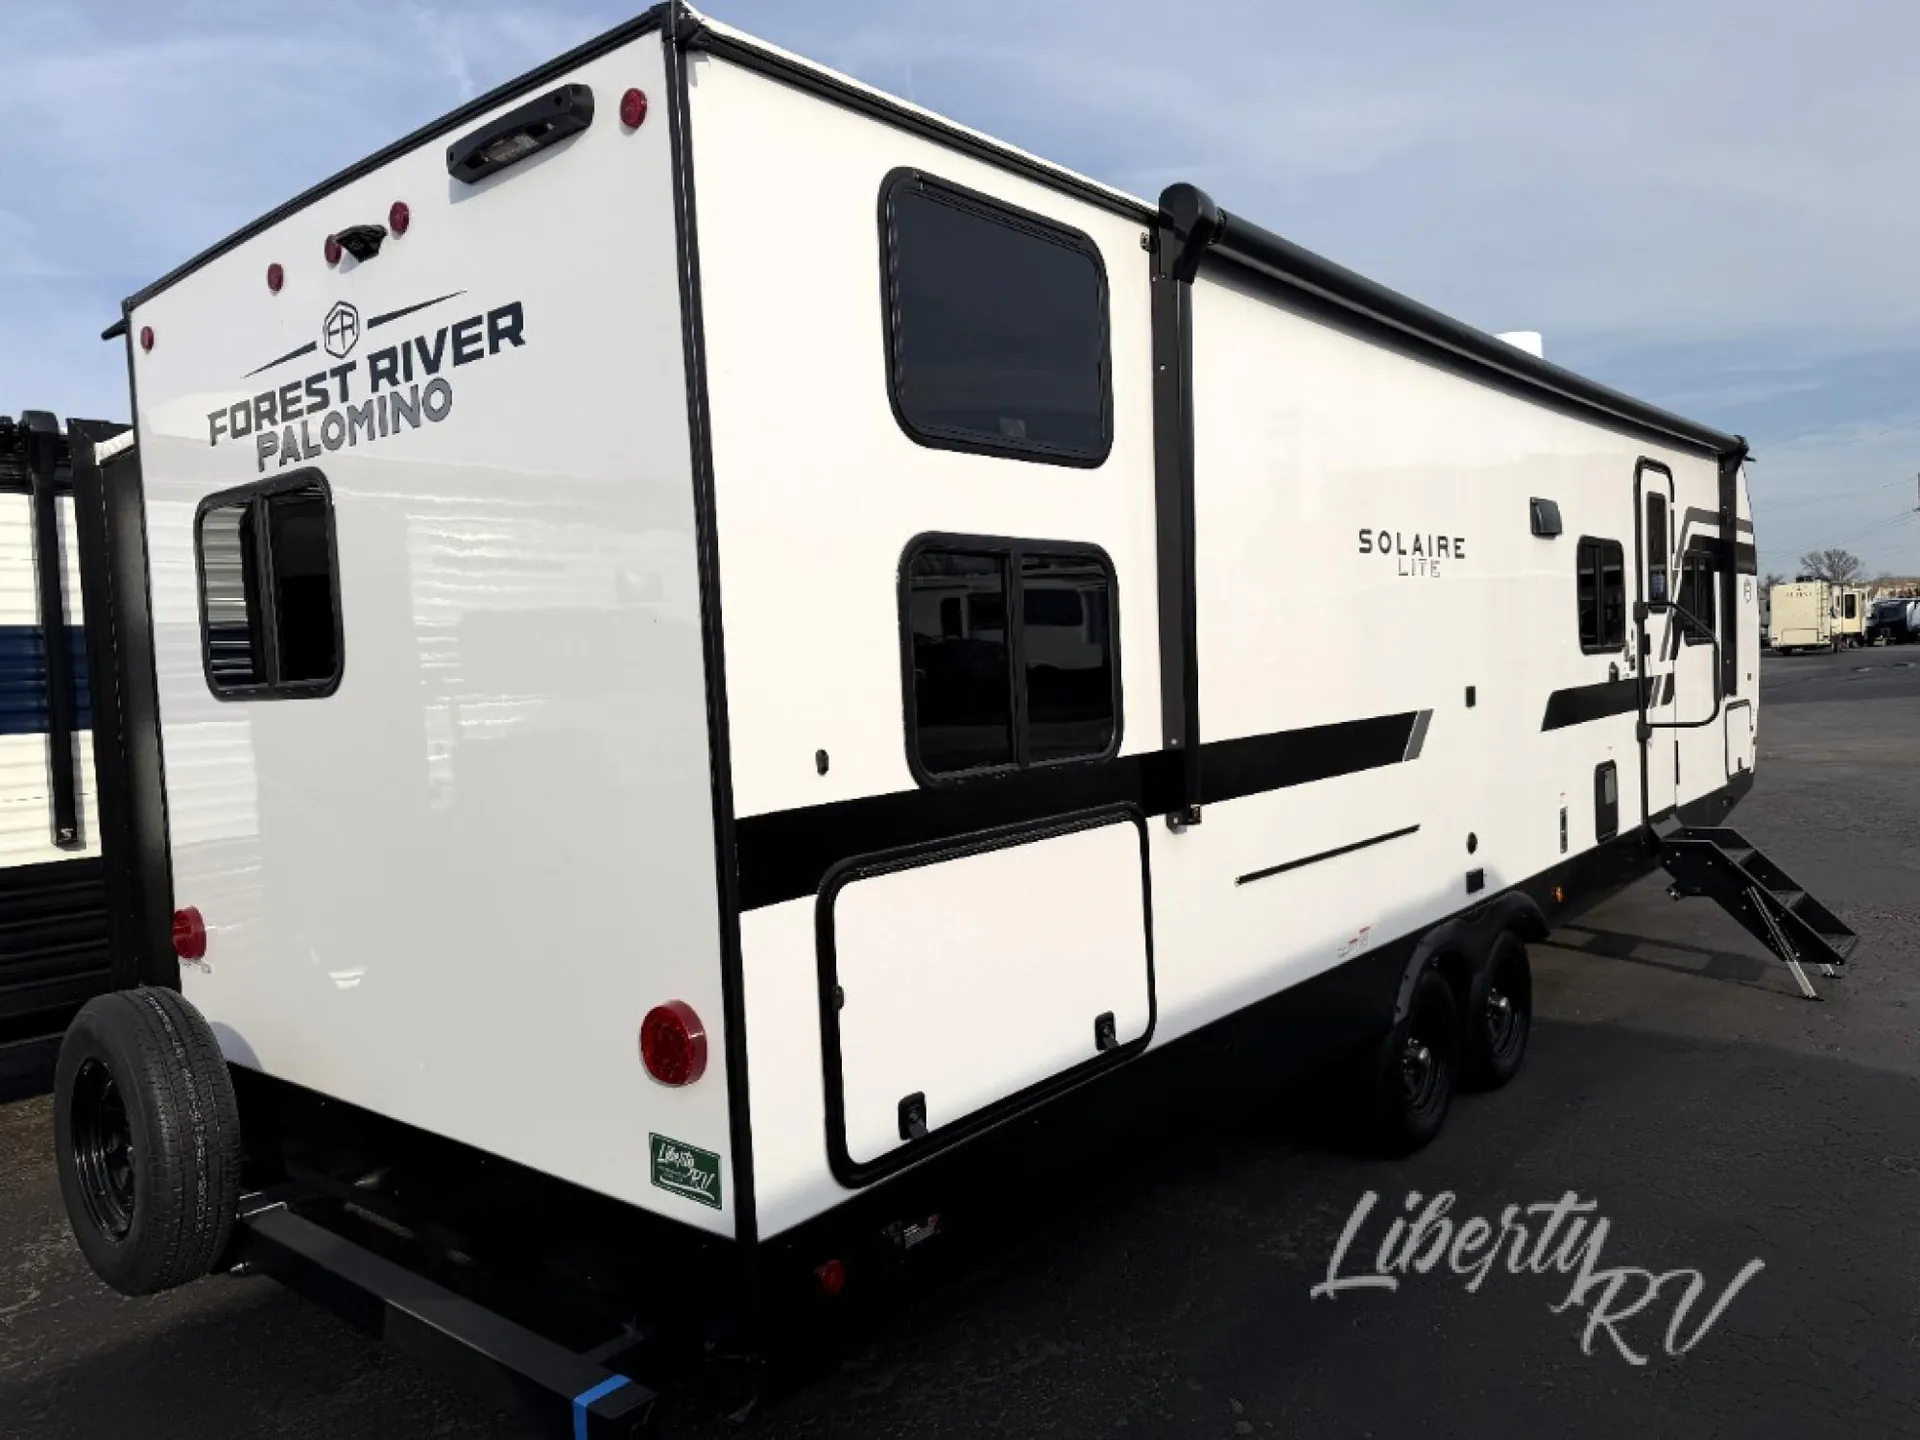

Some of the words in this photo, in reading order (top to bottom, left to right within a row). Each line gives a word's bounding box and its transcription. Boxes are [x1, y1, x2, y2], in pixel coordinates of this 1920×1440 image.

[207, 360, 357, 447] FOREST
[367, 301, 526, 393] RIVER
[256, 377, 453, 472] PALOMINO
[1358, 528, 1466, 559] SOLAIRE
[1397, 557, 1441, 578] LITE
